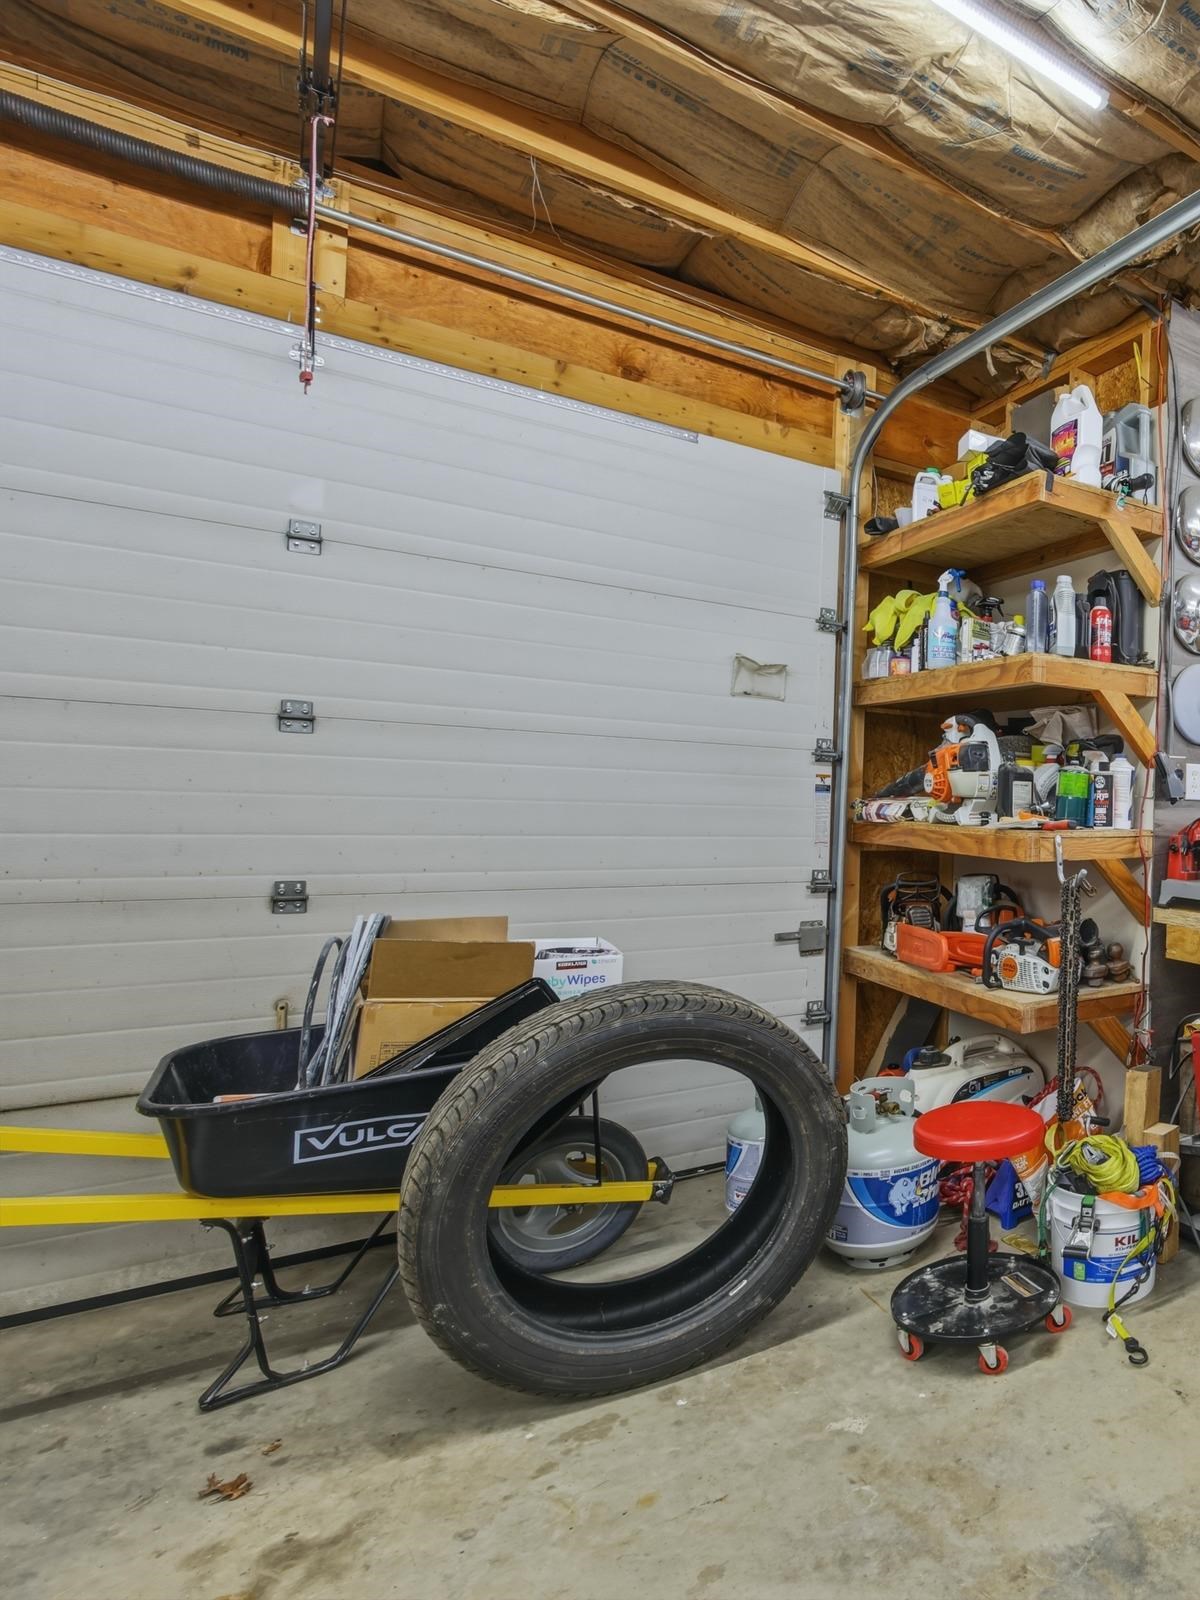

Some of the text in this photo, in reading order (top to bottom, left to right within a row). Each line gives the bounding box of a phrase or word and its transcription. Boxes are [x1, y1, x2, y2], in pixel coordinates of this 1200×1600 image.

[567, 974, 606, 987] Wipes
[306, 1121, 424, 1150] VULC
[1114, 1234, 1139, 1247] KIL
